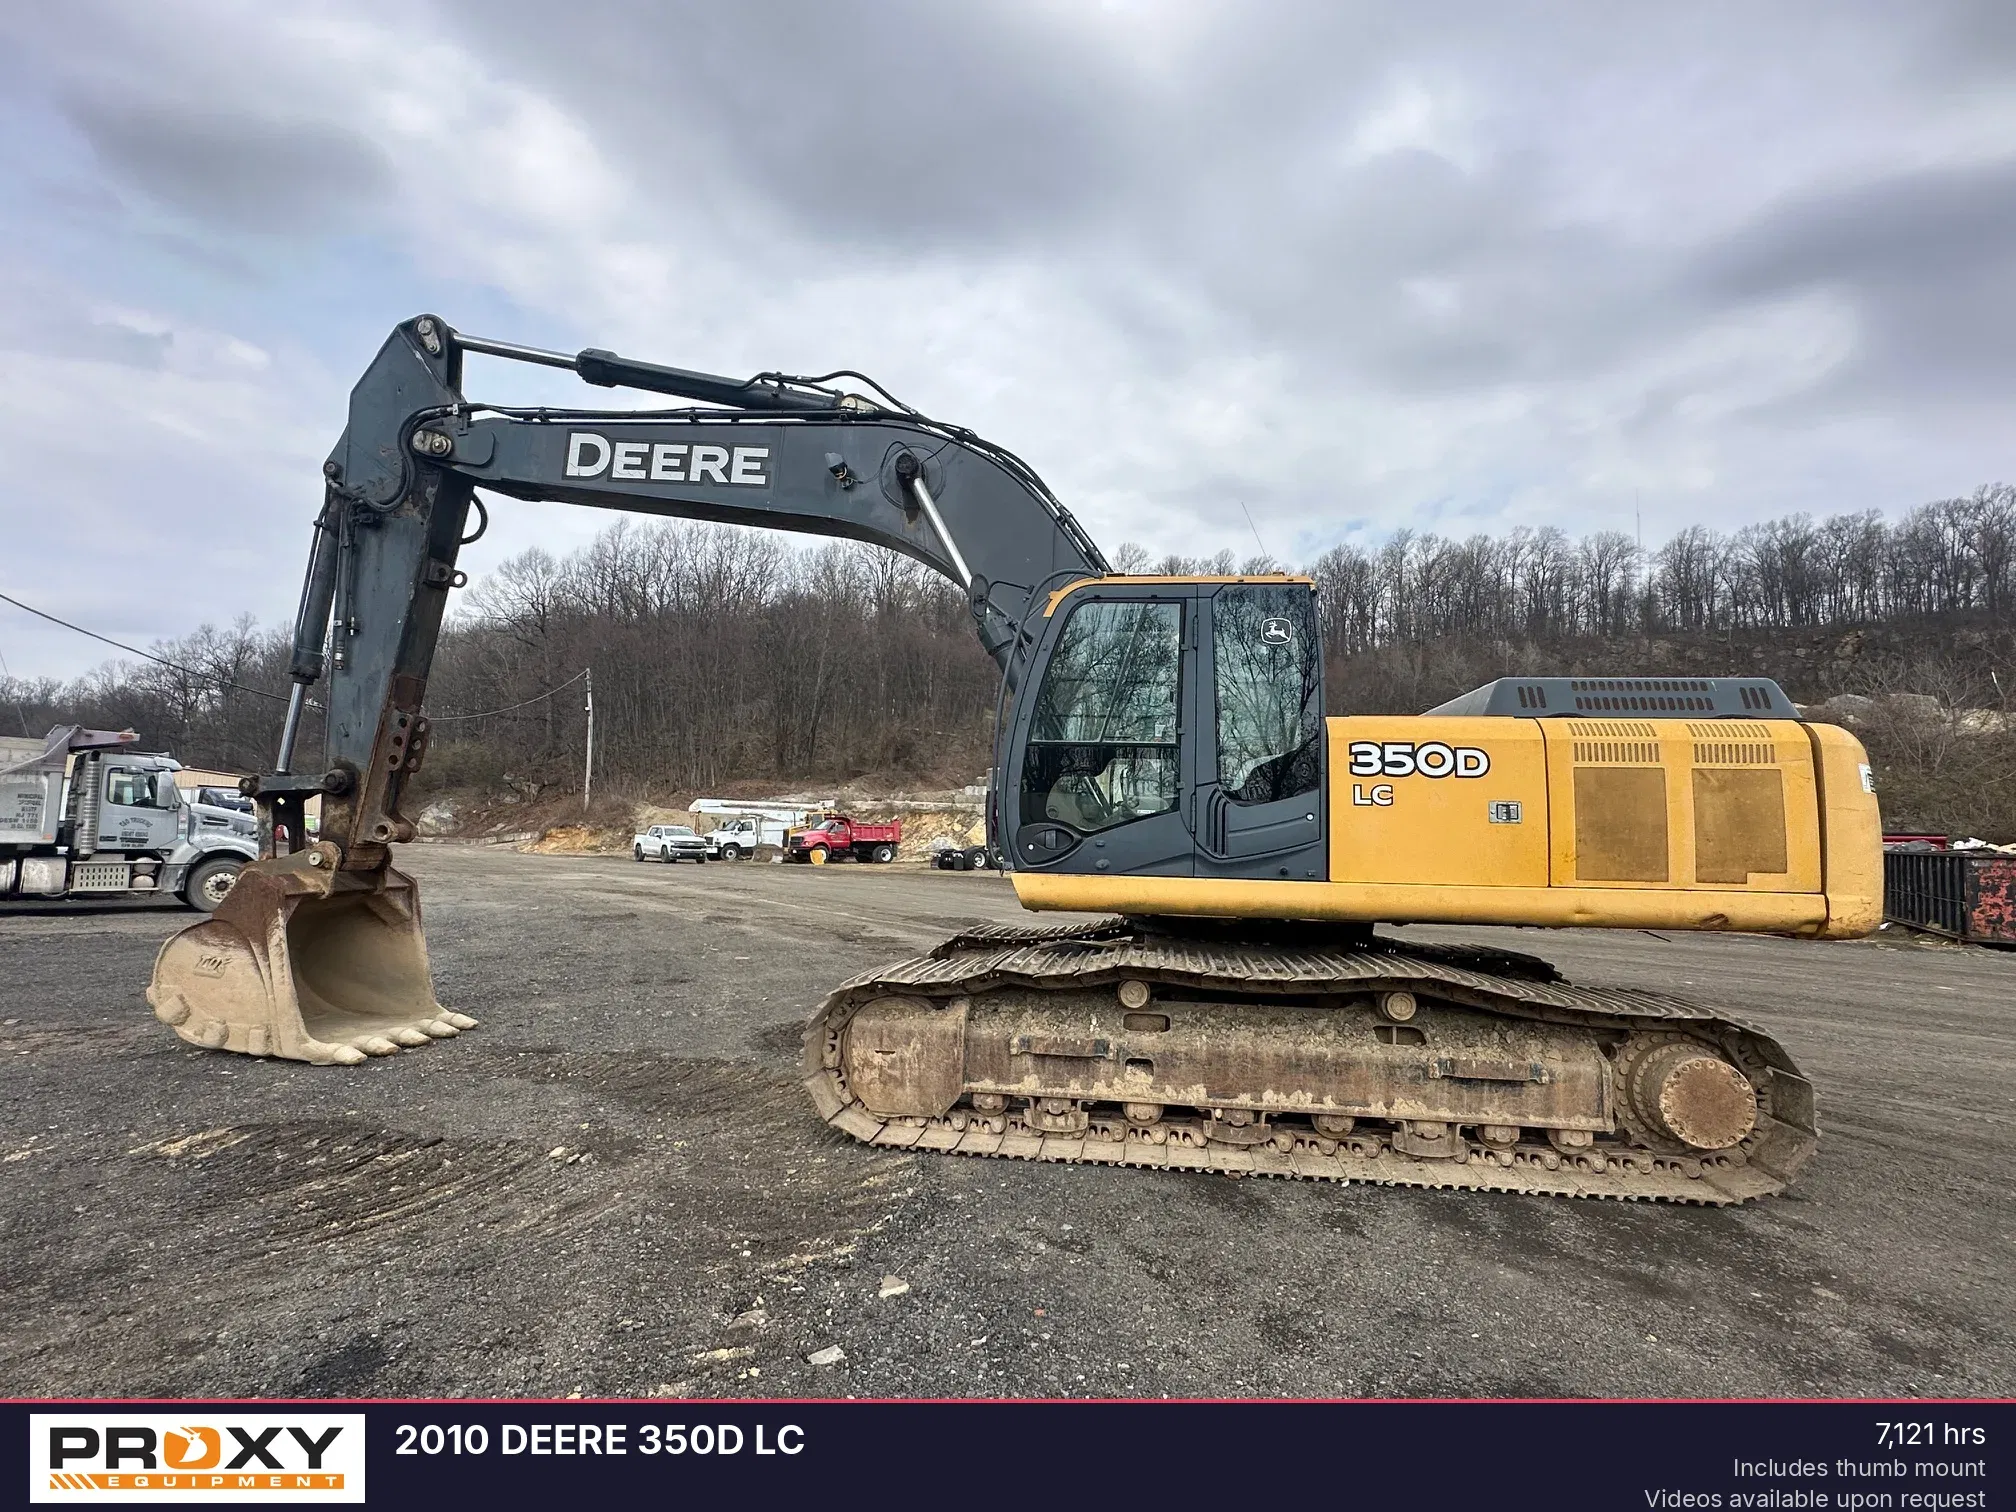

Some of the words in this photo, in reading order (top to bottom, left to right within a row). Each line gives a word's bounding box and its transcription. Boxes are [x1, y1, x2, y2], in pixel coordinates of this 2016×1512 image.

[565, 432, 769, 485] DEERE
[1349, 741, 1491, 779] 350D
[1353, 784, 1393, 806] LC
